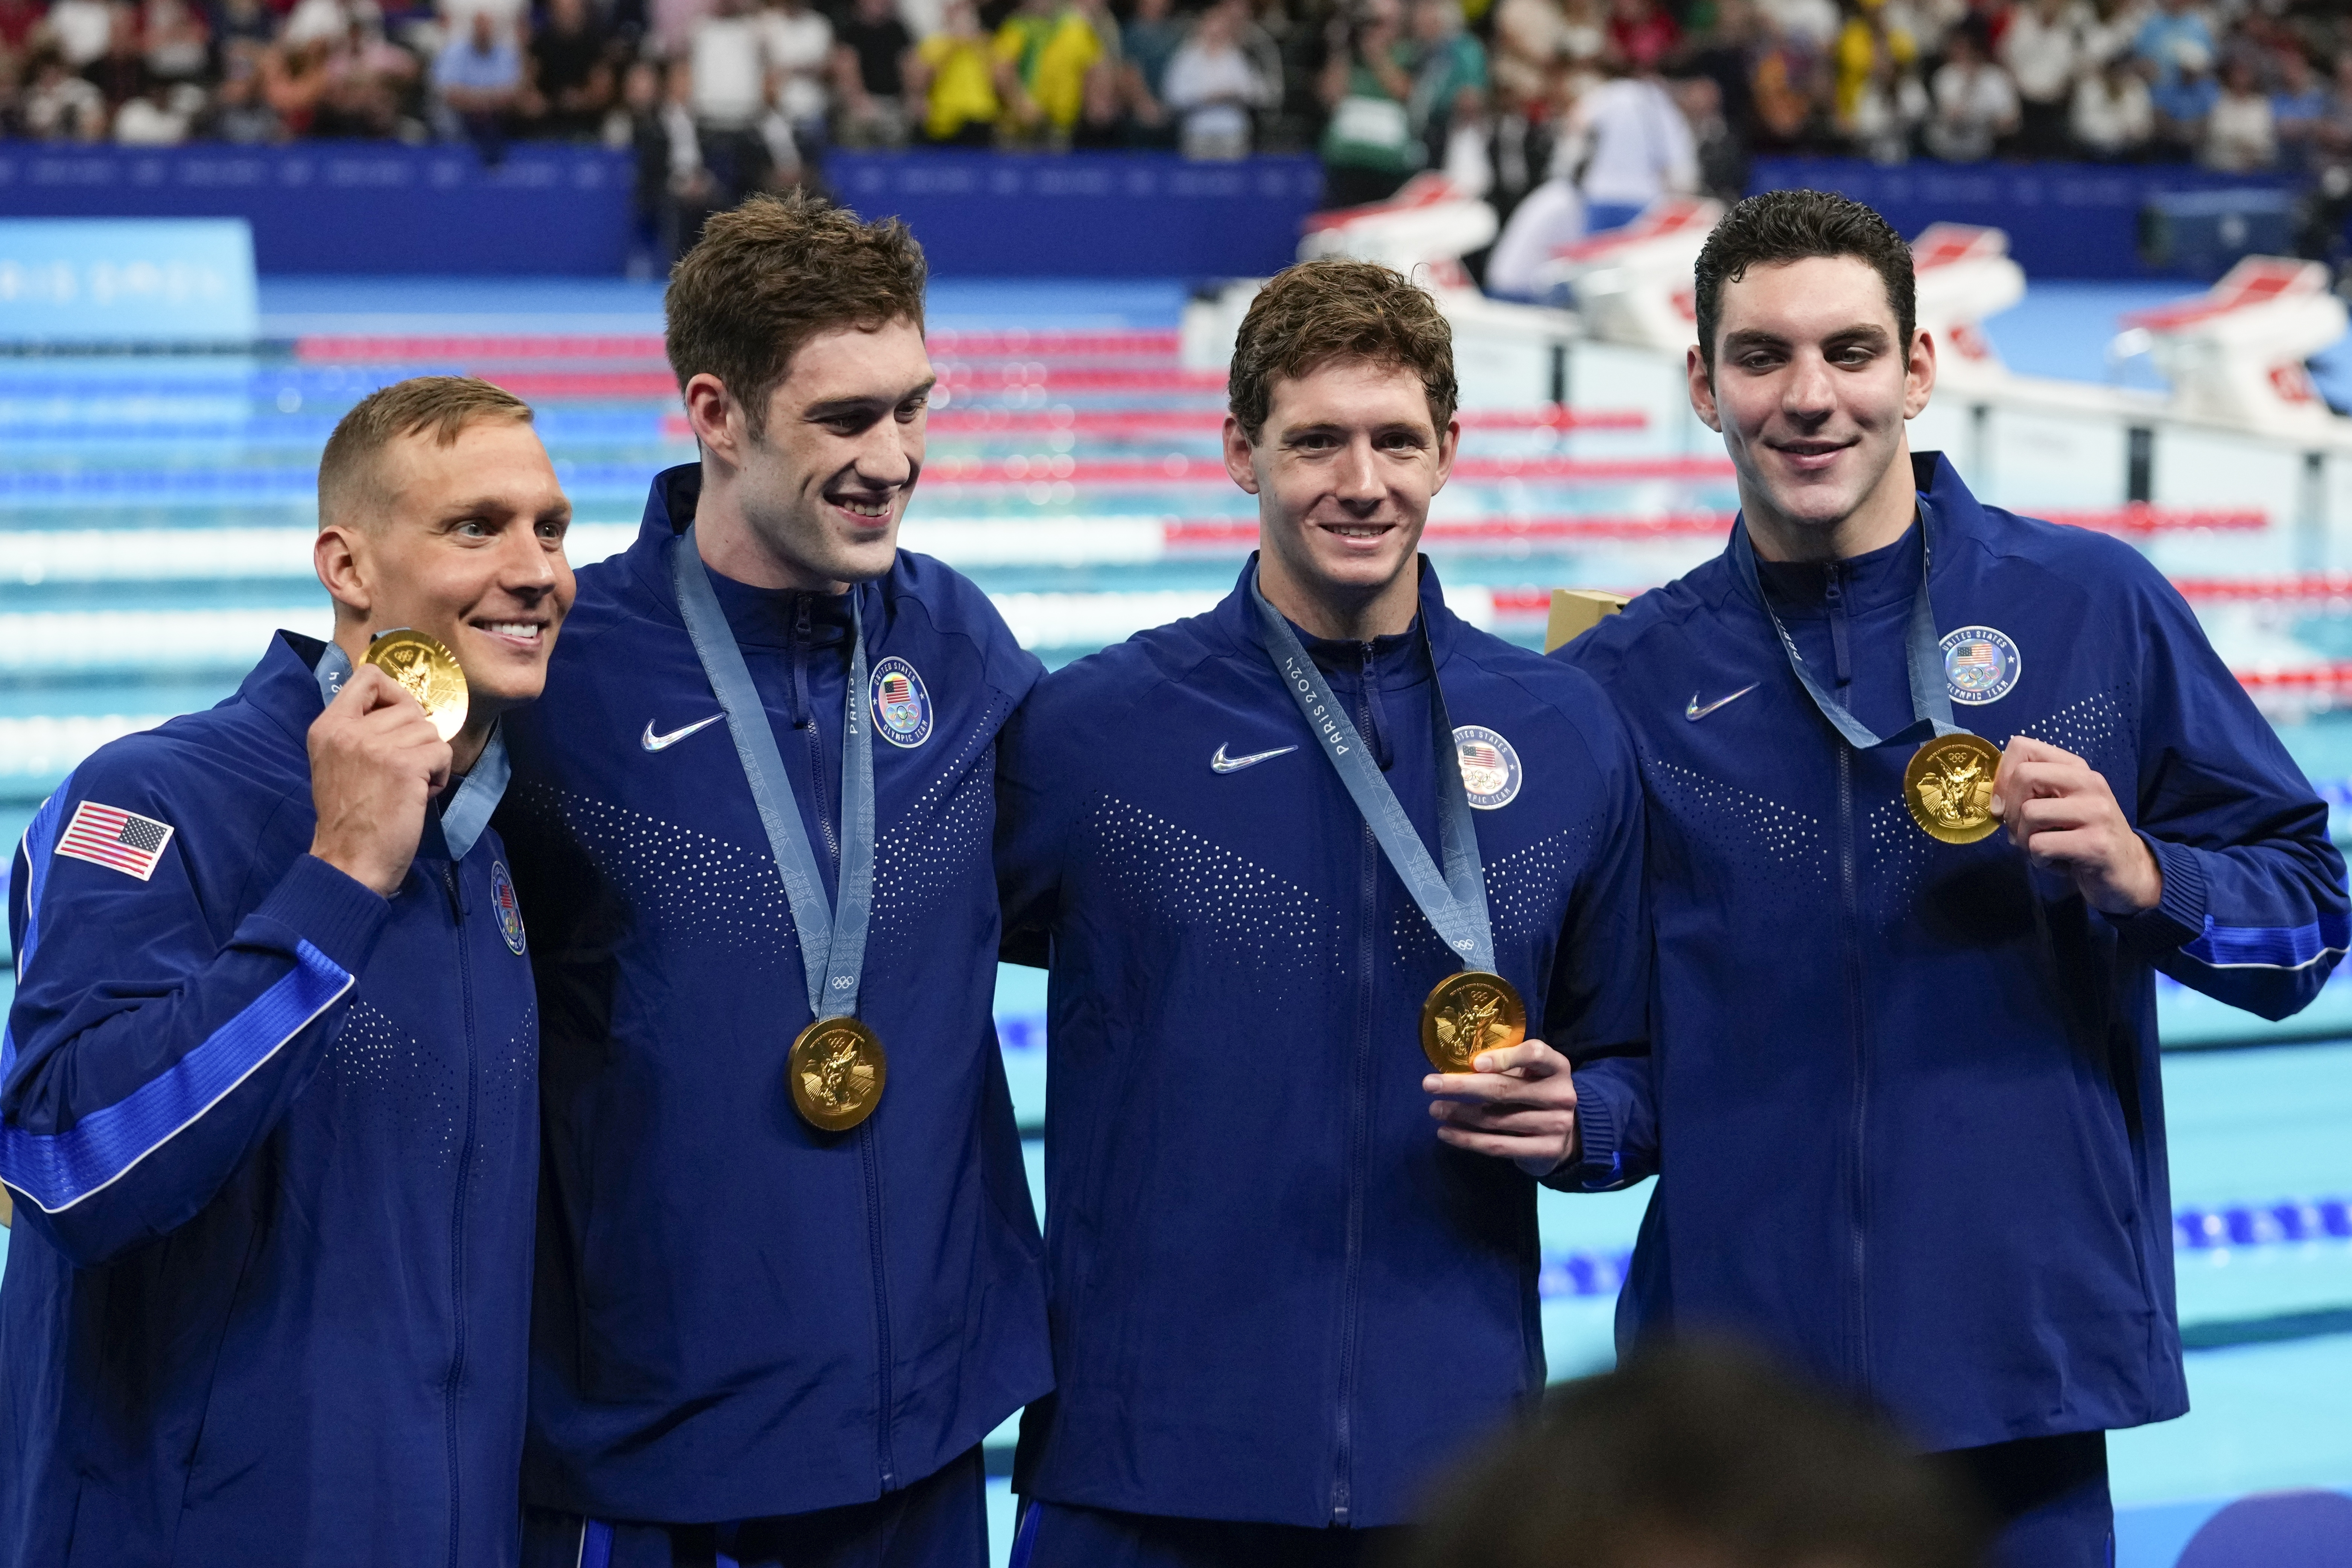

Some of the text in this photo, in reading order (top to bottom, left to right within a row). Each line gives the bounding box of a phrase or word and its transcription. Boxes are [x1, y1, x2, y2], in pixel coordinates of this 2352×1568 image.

[1942, 630, 2007, 651] UNITED STATES
[329, 672, 342, 693] 24
[874, 662, 916, 685] UNITED STATES
[1286, 657, 1317, 703] 2024
[1986, 680, 2008, 697] TEAM
[883, 719, 928, 742] OLYMPIC TEAM
[1454, 730, 1508, 753] NITED STATES
[1467, 787, 1511, 803] MPIC TEAM
